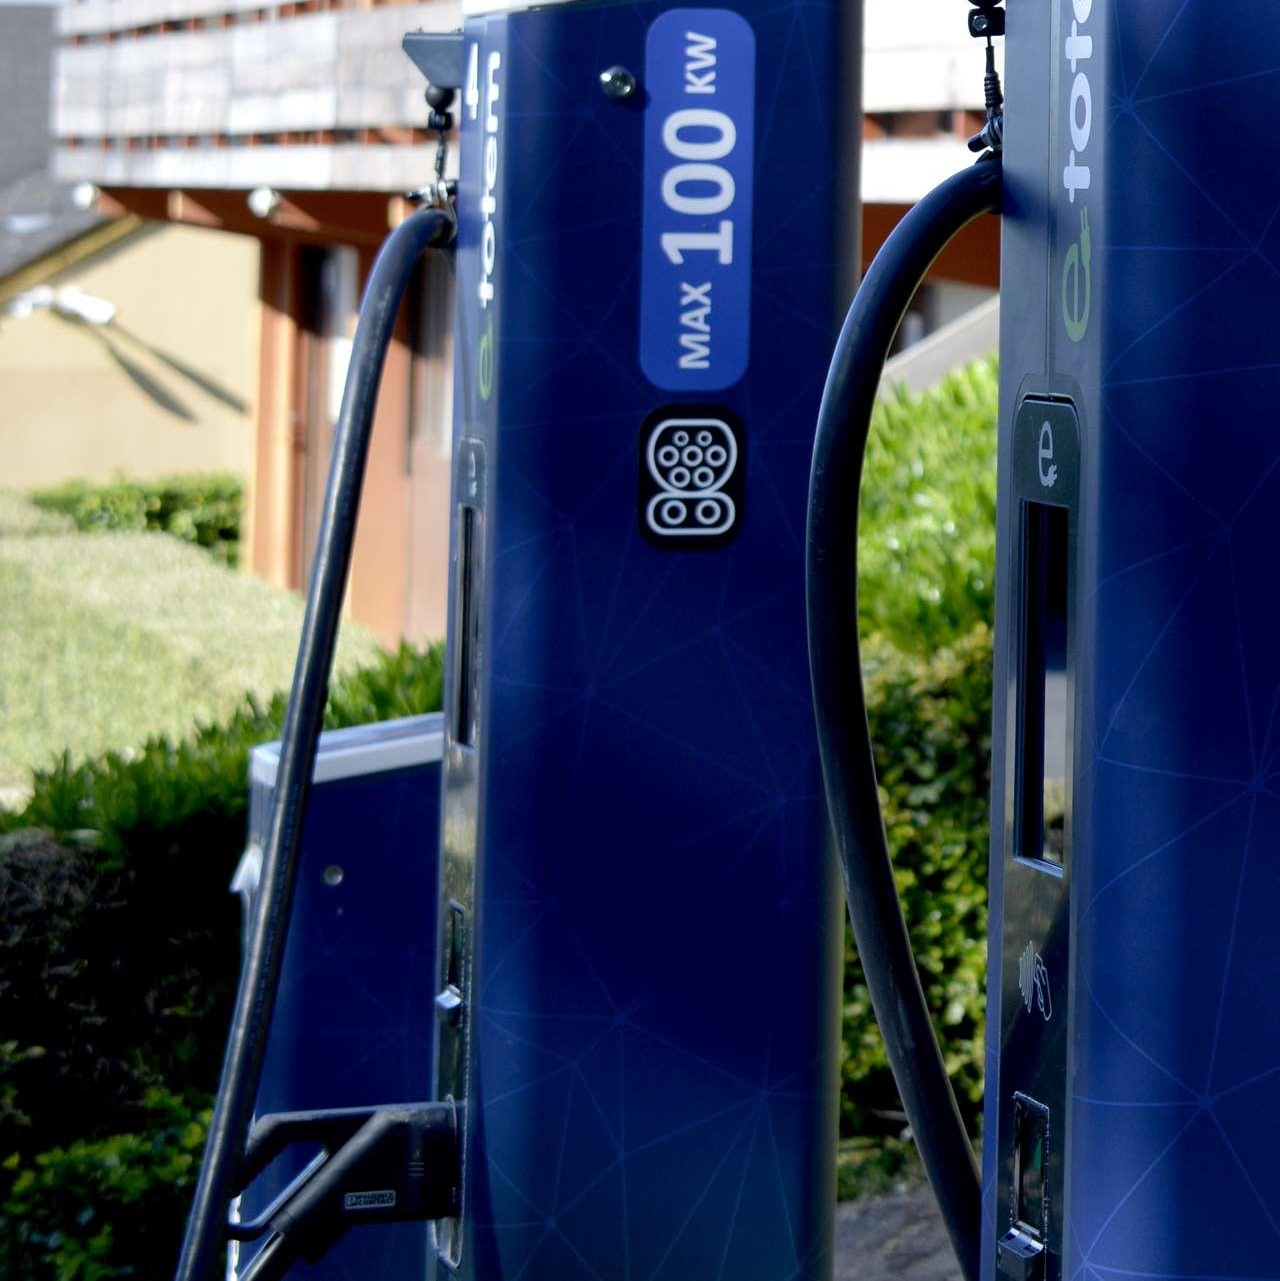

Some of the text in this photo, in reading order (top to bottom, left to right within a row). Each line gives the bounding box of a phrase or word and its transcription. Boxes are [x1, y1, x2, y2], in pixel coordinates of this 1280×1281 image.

[465, 42, 479, 120] 4
[661, 31, 737, 371] MAX 100 KW
